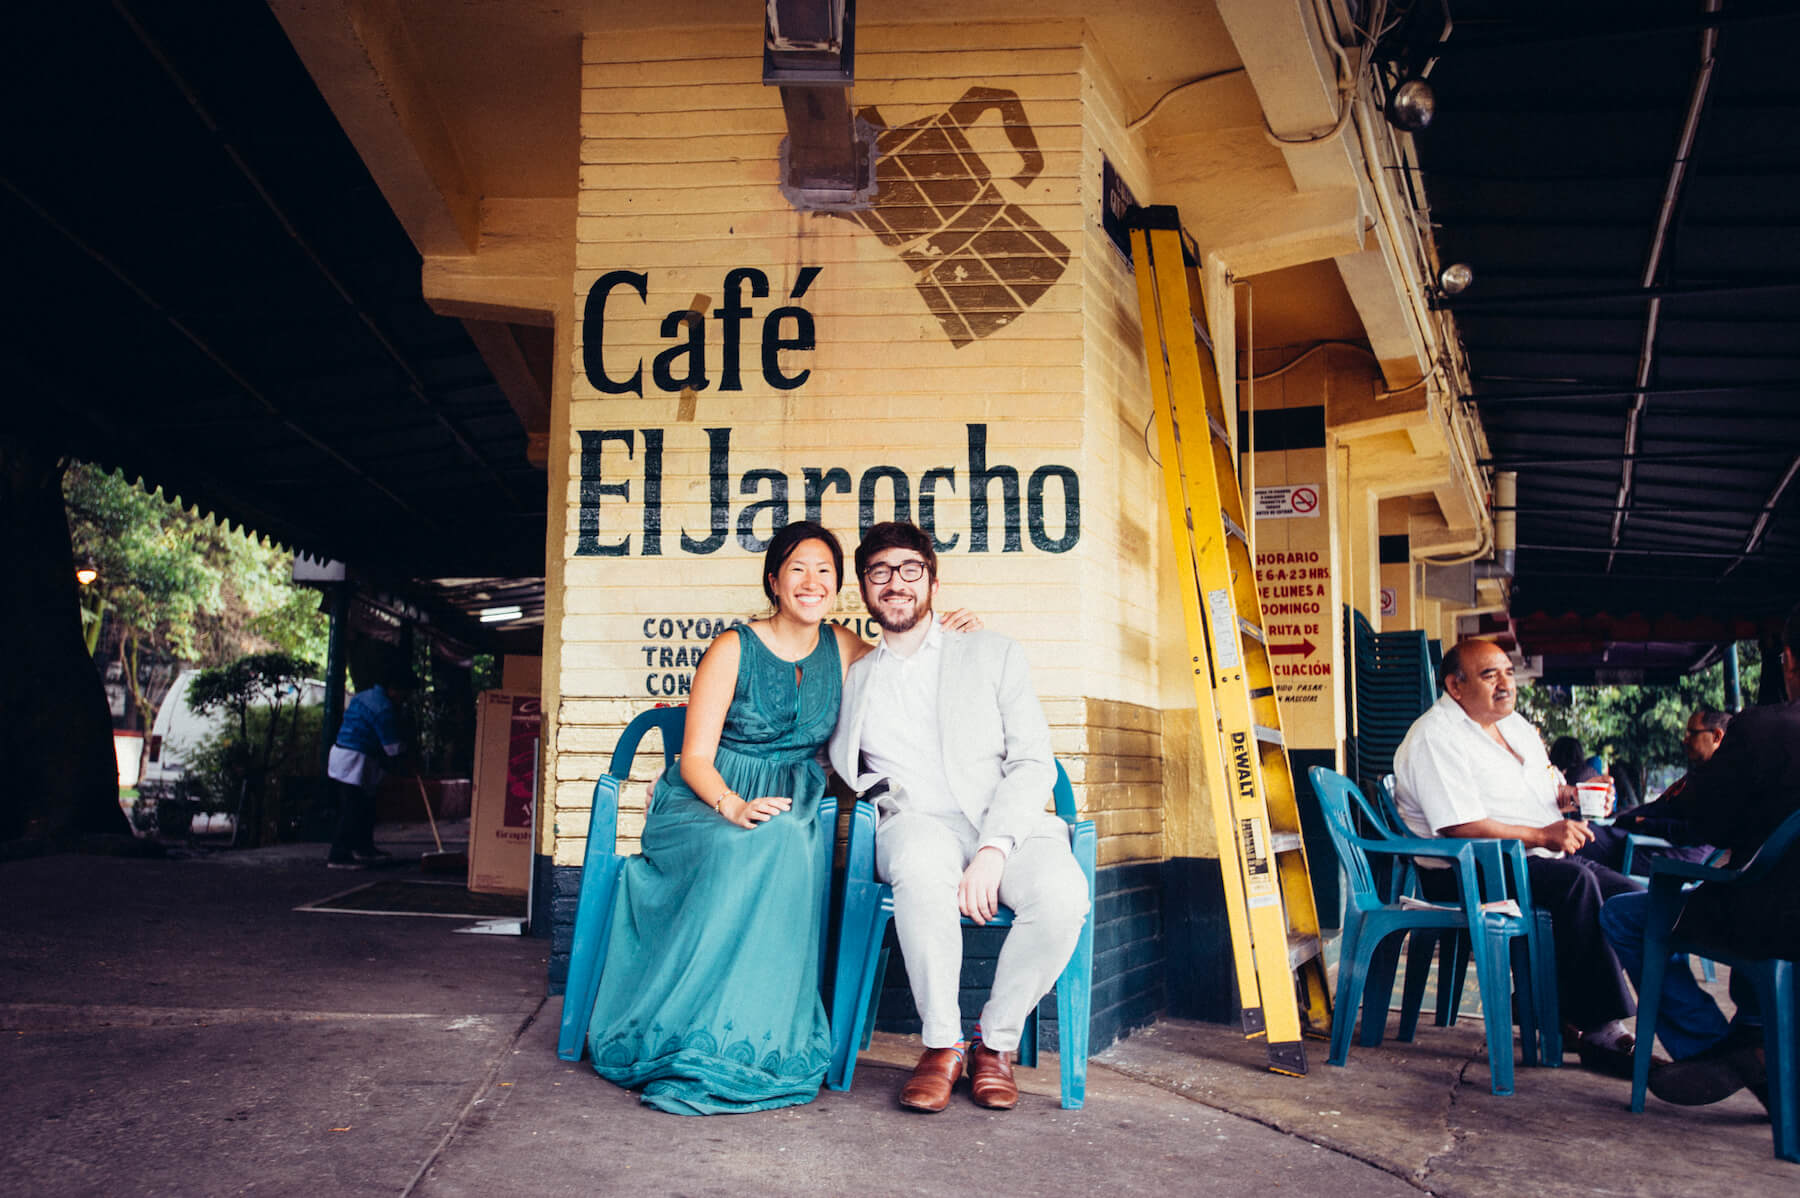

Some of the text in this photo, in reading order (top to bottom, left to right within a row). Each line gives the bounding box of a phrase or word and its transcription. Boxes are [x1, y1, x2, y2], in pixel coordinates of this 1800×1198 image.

[582, 267, 823, 399] Café
[574, 423, 1081, 556] El Jarocho
[1256, 551, 1319, 566] HORARIO
[1256, 569, 1262, 581] E
[1273, 584, 1313, 598] LUNES
[1316, 583, 1325, 596] A
[1261, 602, 1320, 616] DOMINGO
[1268, 623, 1319, 636] RUTA DE
[641, 646, 709, 667] TRAD
